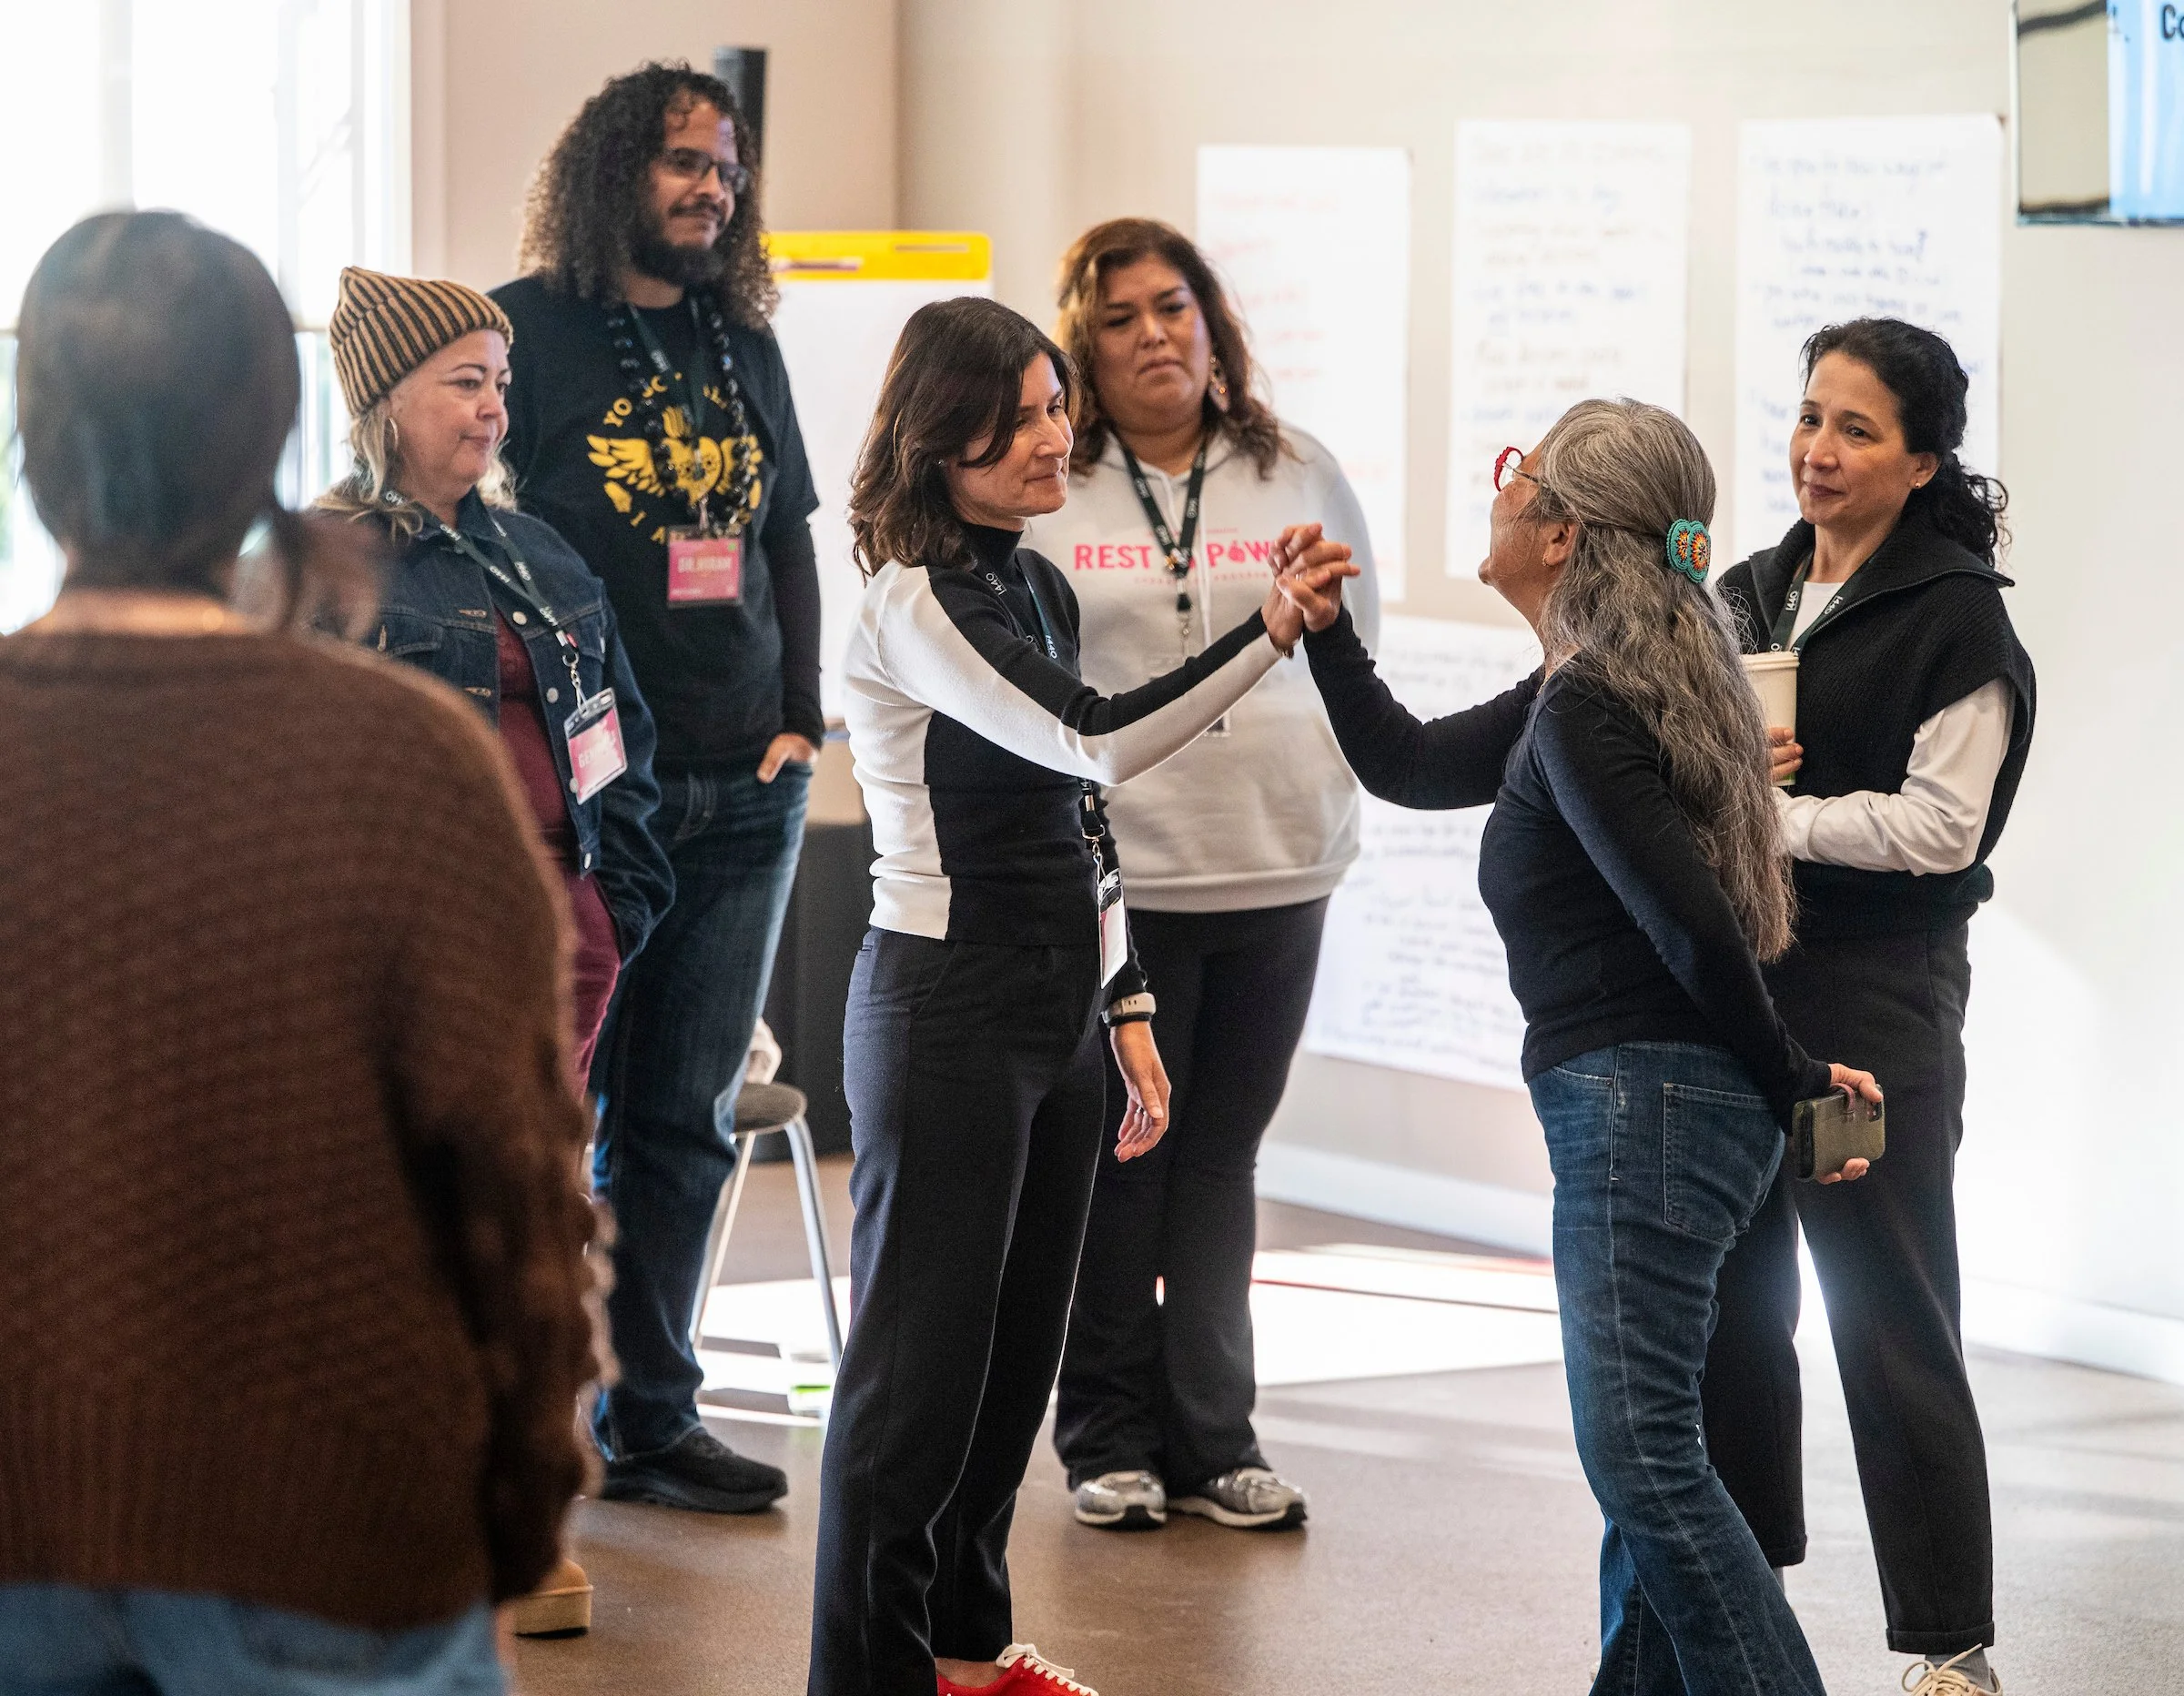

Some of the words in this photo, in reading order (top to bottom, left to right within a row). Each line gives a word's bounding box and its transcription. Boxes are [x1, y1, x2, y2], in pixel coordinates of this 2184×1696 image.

[1074, 543, 1152, 570] REST
[1206, 540, 1271, 568] POW
[986, 572, 1006, 595] 1440
[1785, 591, 1799, 611] 1440
[1825, 596, 1843, 614] 1440
[1044, 634, 1057, 659] 1440
